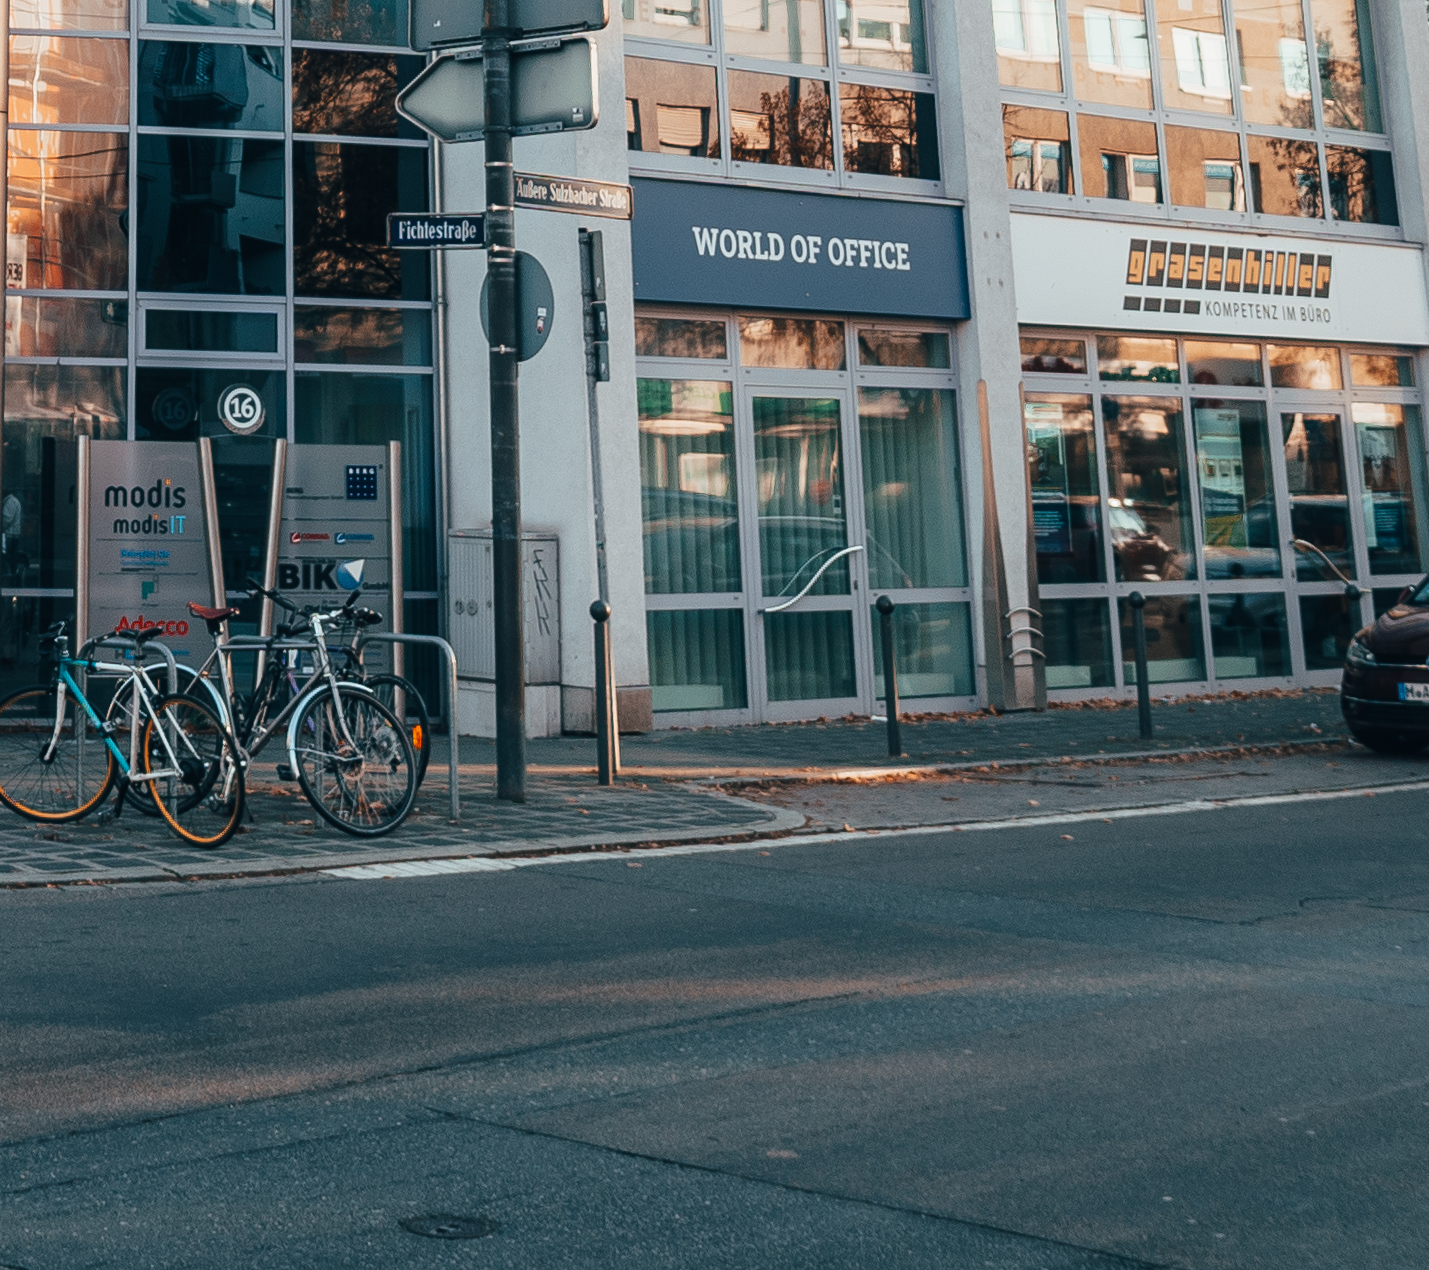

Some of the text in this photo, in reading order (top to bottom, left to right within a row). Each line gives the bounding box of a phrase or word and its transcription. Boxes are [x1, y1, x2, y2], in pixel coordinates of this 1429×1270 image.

[515, 176, 627, 209] Äußere Sulzbacher Straße
[398, 220, 477, 242] Fichtestraße
[692, 226, 911, 271] WORLD OF OFFICE
[1126, 245, 1331, 294] grasenhiller
[1204, 301, 1331, 323] KOMPETENZ IM BÜRO
[230, 397, 255, 418] 16
[105, 478, 186, 509] modis
